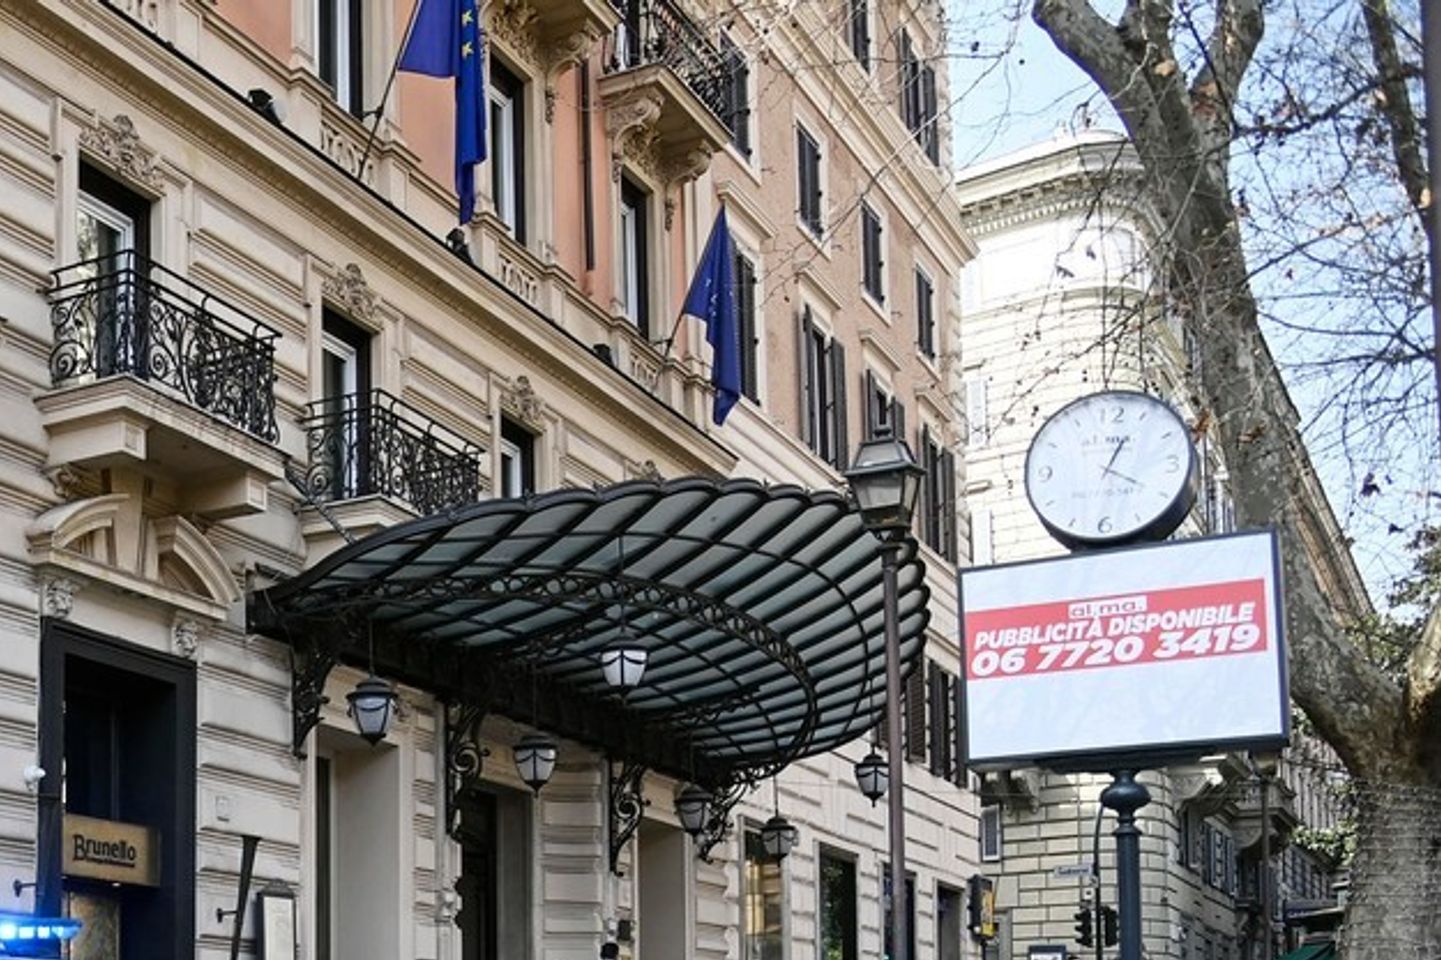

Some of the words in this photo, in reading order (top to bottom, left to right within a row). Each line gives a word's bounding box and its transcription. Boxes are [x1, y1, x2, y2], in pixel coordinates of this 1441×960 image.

[1100, 406, 1125, 424] 12
[1038, 465, 1053, 483] 9
[1166, 454, 1180, 474] 3
[1097, 516, 1113, 534] 6
[973, 614, 1104, 651] PUBBLICITÀ
[1107, 602, 1256, 637] DISPONIBILE
[971, 646, 1028, 677] 06
[1035, 635, 1145, 671] 7720
[1152, 624, 1261, 659] 3419
[72, 833, 137, 862] Brunello
